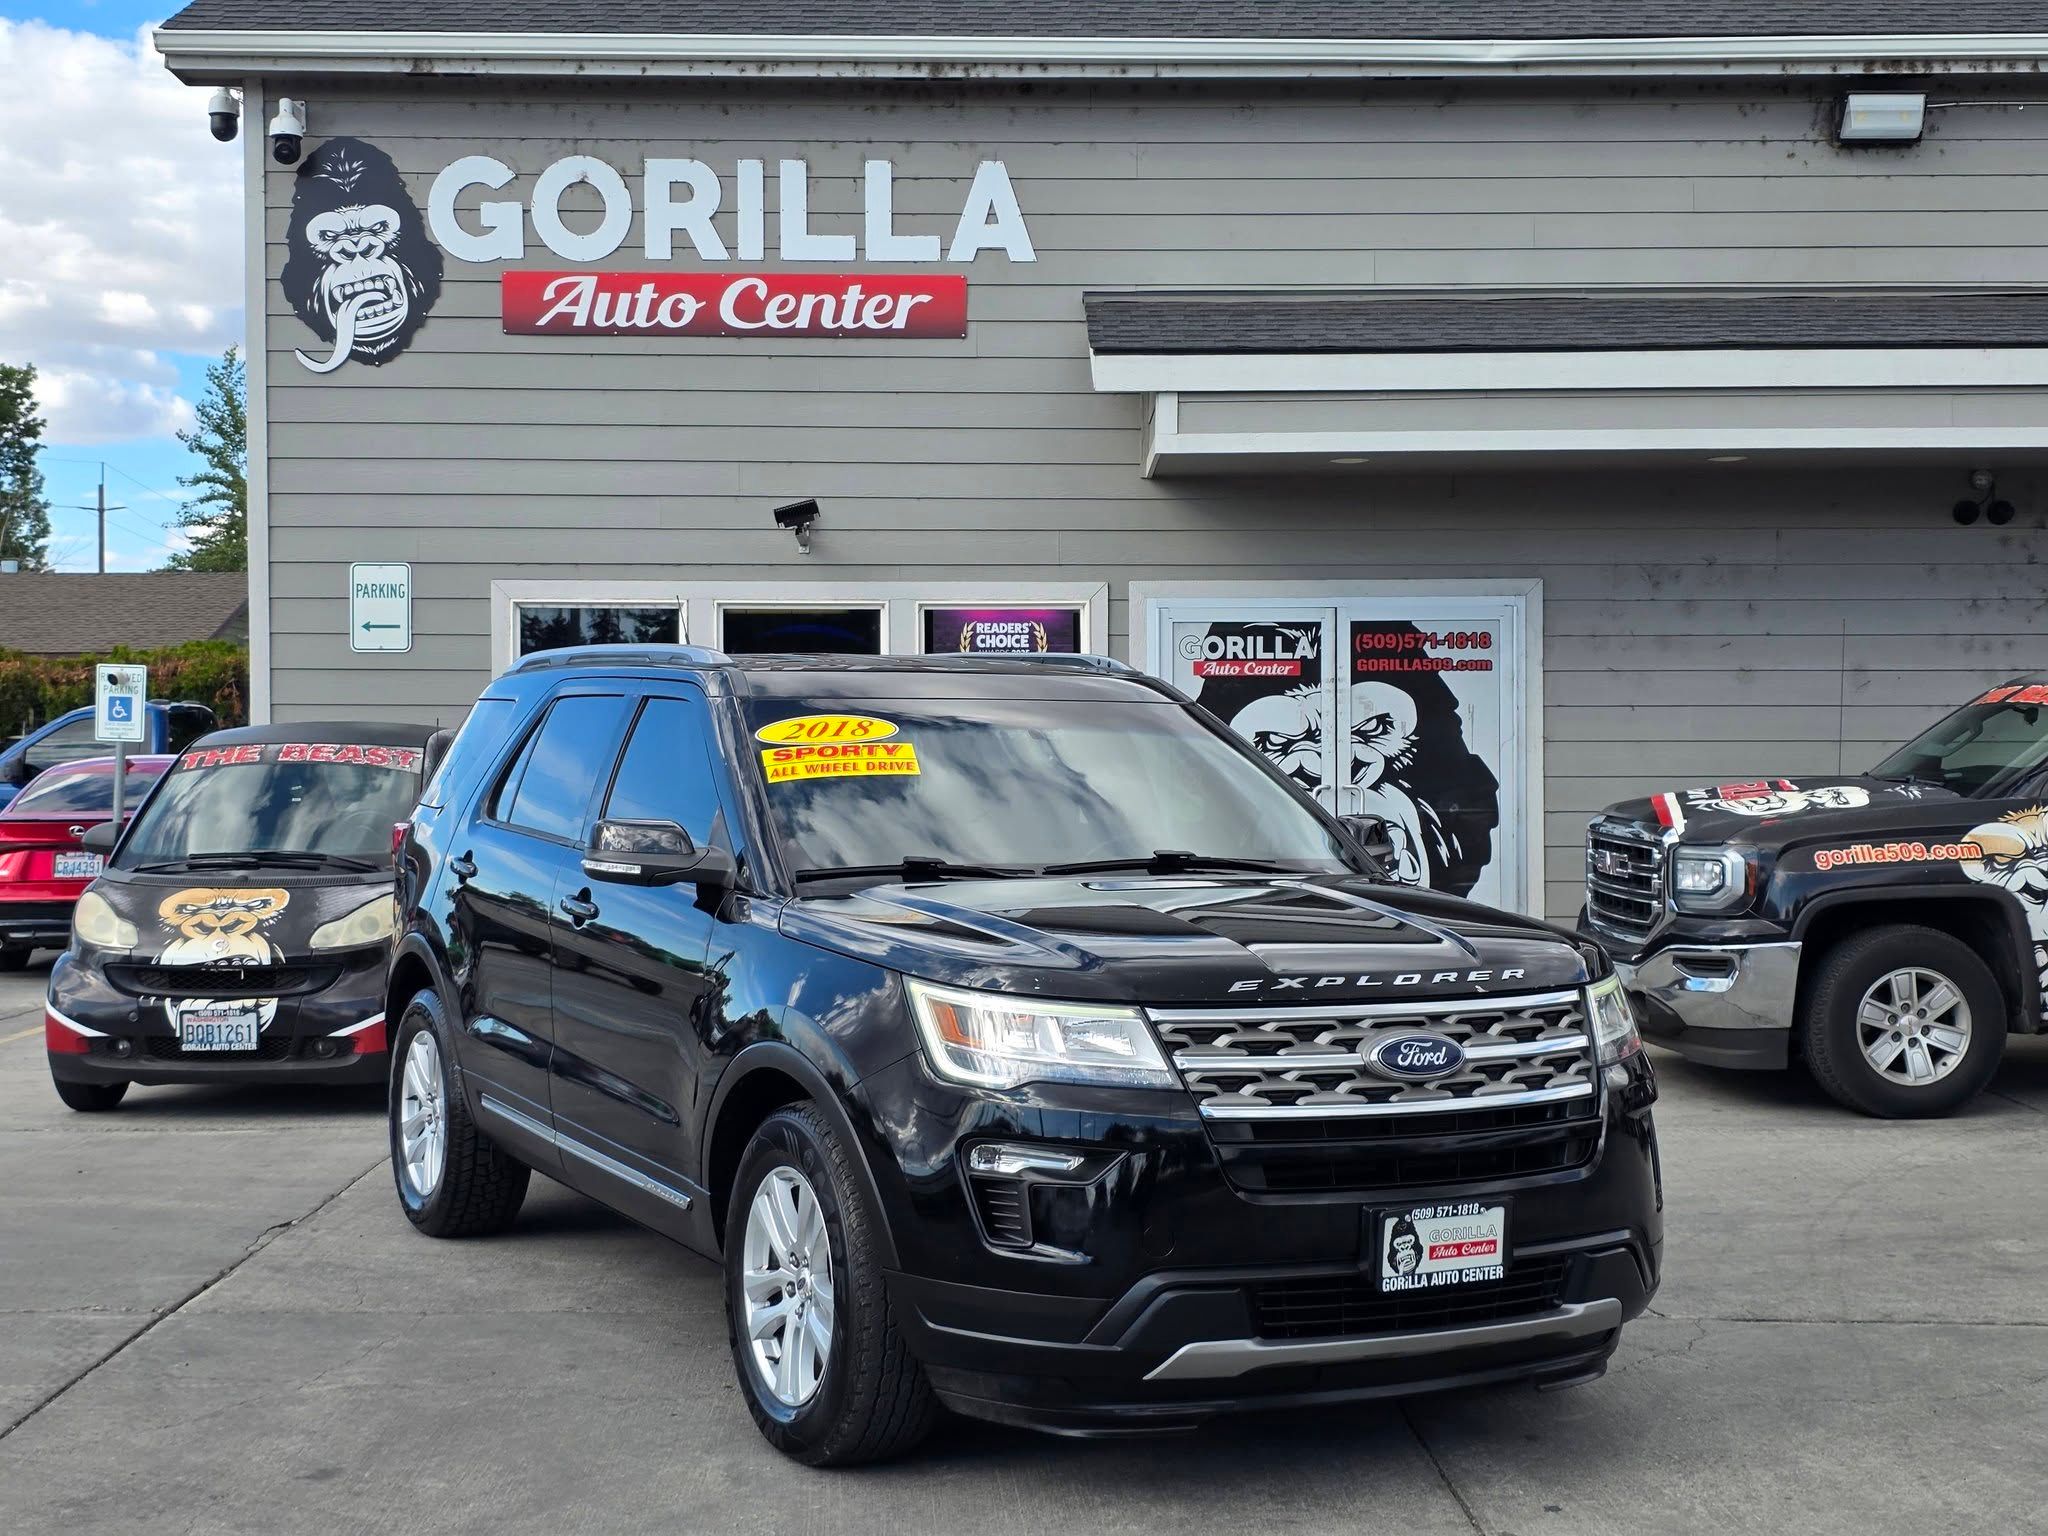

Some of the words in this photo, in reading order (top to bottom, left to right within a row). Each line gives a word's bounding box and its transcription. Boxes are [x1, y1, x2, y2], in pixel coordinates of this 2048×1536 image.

[427, 154, 1037, 263] GORILLA
[535, 276, 706, 329] Auto
[718, 278, 930, 330] Center
[355, 583, 405, 599] PARKING
[976, 622, 1032, 634] READERS'
[976, 634, 1030, 648] CHOICE
[1178, 634, 1316, 661] GORILLA
[1354, 631, 1493, 654] (509)571-1818
[1202, 661, 1241, 676] Auto
[1243, 661, 1294, 676] Center
[1355, 657, 1493, 672] GORILLA509.com
[103, 685, 139, 695] PARKING
[780, 719, 874, 741] 2018
[180, 744, 266, 771] THE
[277, 743, 422, 769] BEAST
[772, 744, 901, 762] SPORTY
[770, 765, 800, 779] ALL
[804, 762, 861, 774] WHEEL
[866, 761, 916, 772] DRIVE
[1814, 842, 1983, 871] gorilla509.com
[1228, 968, 1525, 993] EXPLORER
[185, 1024, 252, 1043] BQB1261
[211, 1042, 230, 1051] AUTO
[230, 1042, 258, 1051] CENTER
[1397, 1041, 1447, 1067] Ford
[1411, 1207, 1435, 1221] (509)
[1436, 1203, 1480, 1218] 571-1818
[1429, 1225, 1498, 1243] GORILLA
[1432, 1246, 1459, 1258] Auto
[1461, 1243, 1496, 1256] Center
[1382, 1273, 1429, 1293] GORILLA
[1430, 1270, 1460, 1287] AUTO
[1461, 1266, 1504, 1283] CENTER
